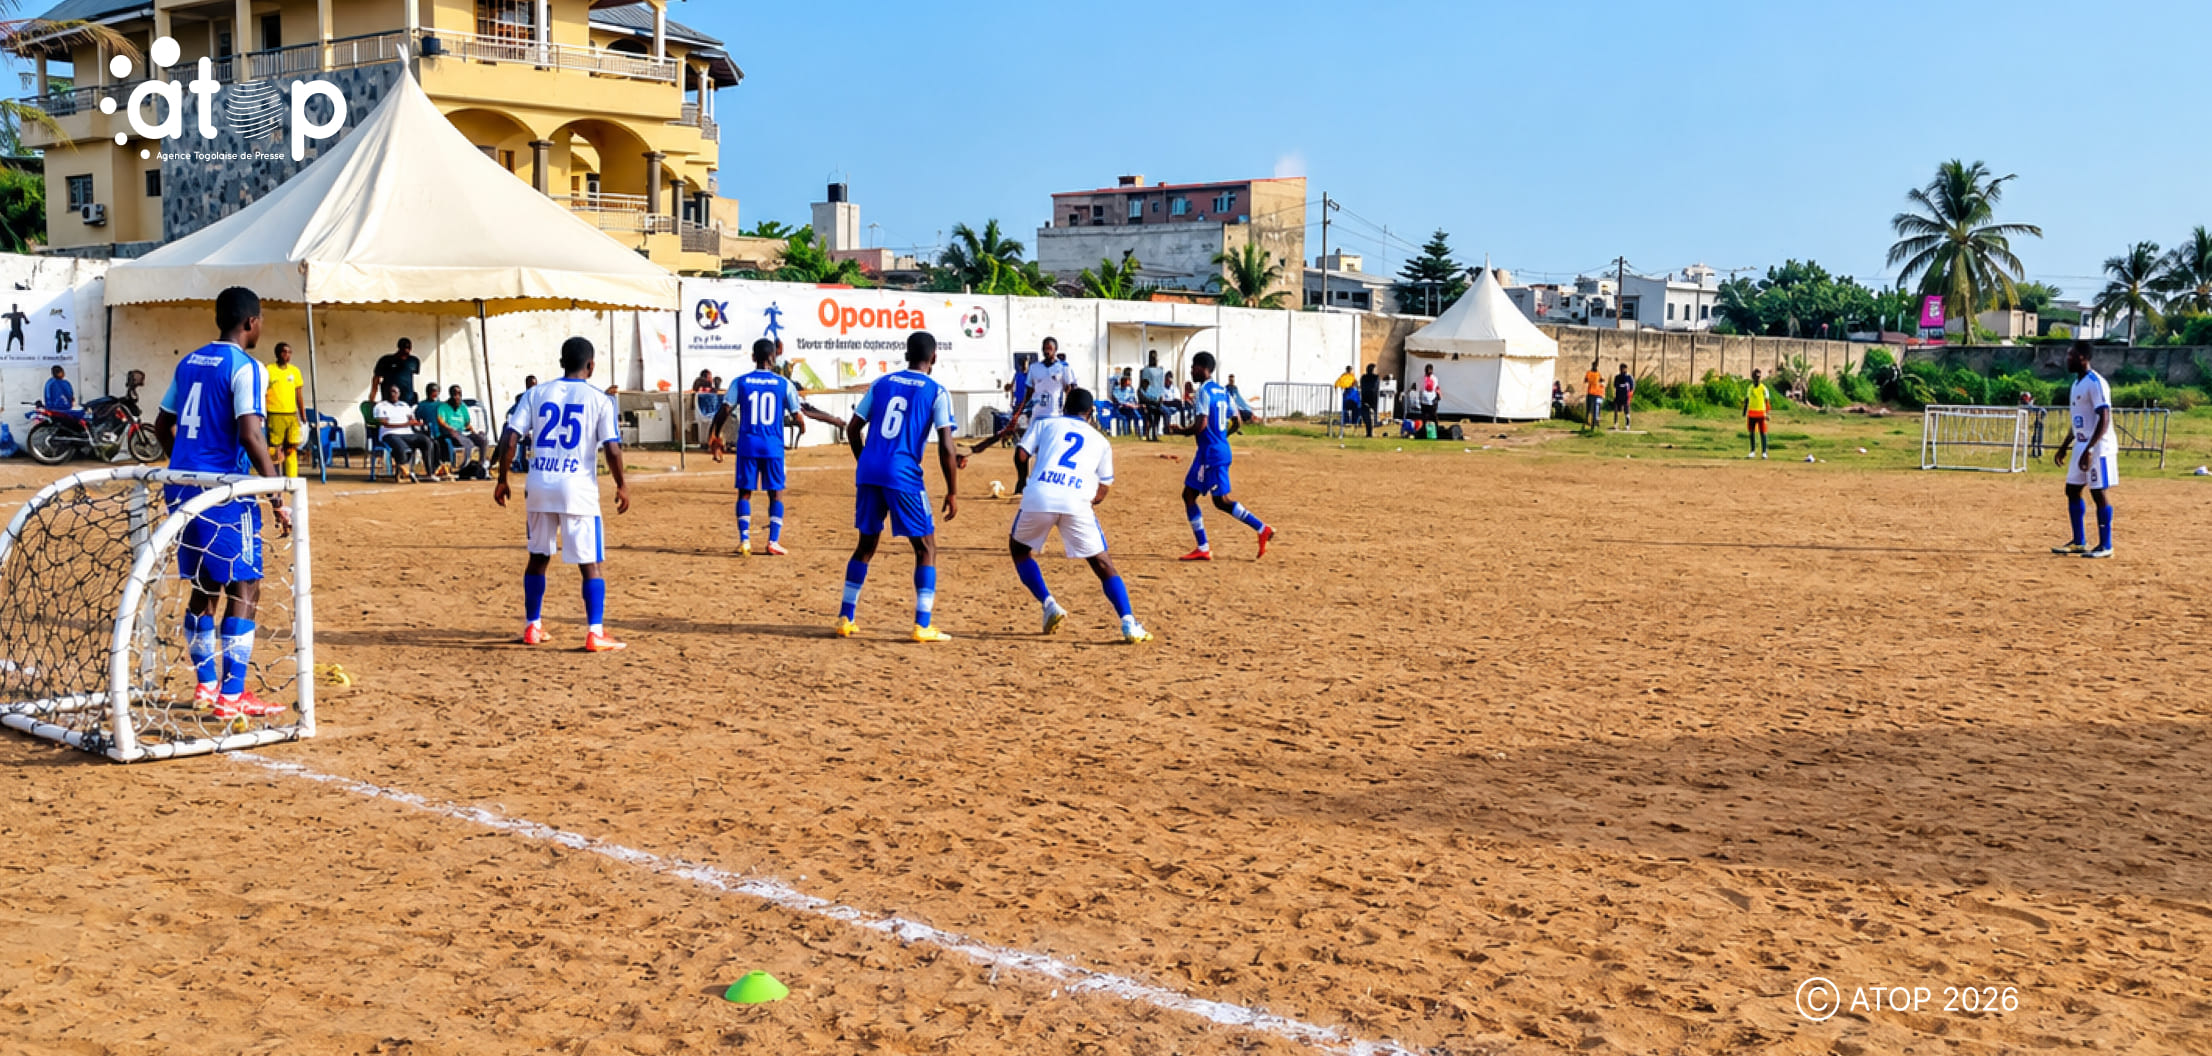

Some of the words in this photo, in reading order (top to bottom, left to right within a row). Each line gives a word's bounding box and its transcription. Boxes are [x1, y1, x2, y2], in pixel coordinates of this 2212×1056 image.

[818, 298, 926, 335] Oponéa
[180, 382, 203, 439] 4
[536, 401, 585, 450] 25
[748, 390, 776, 426] 10
[881, 396, 908, 440] 6
[531, 457, 560, 472] AZUL
[562, 458, 579, 473] FC
[1057, 431, 1084, 470] 2
[1038, 471, 1066, 485] AZUL
[1068, 476, 1083, 489] FC
